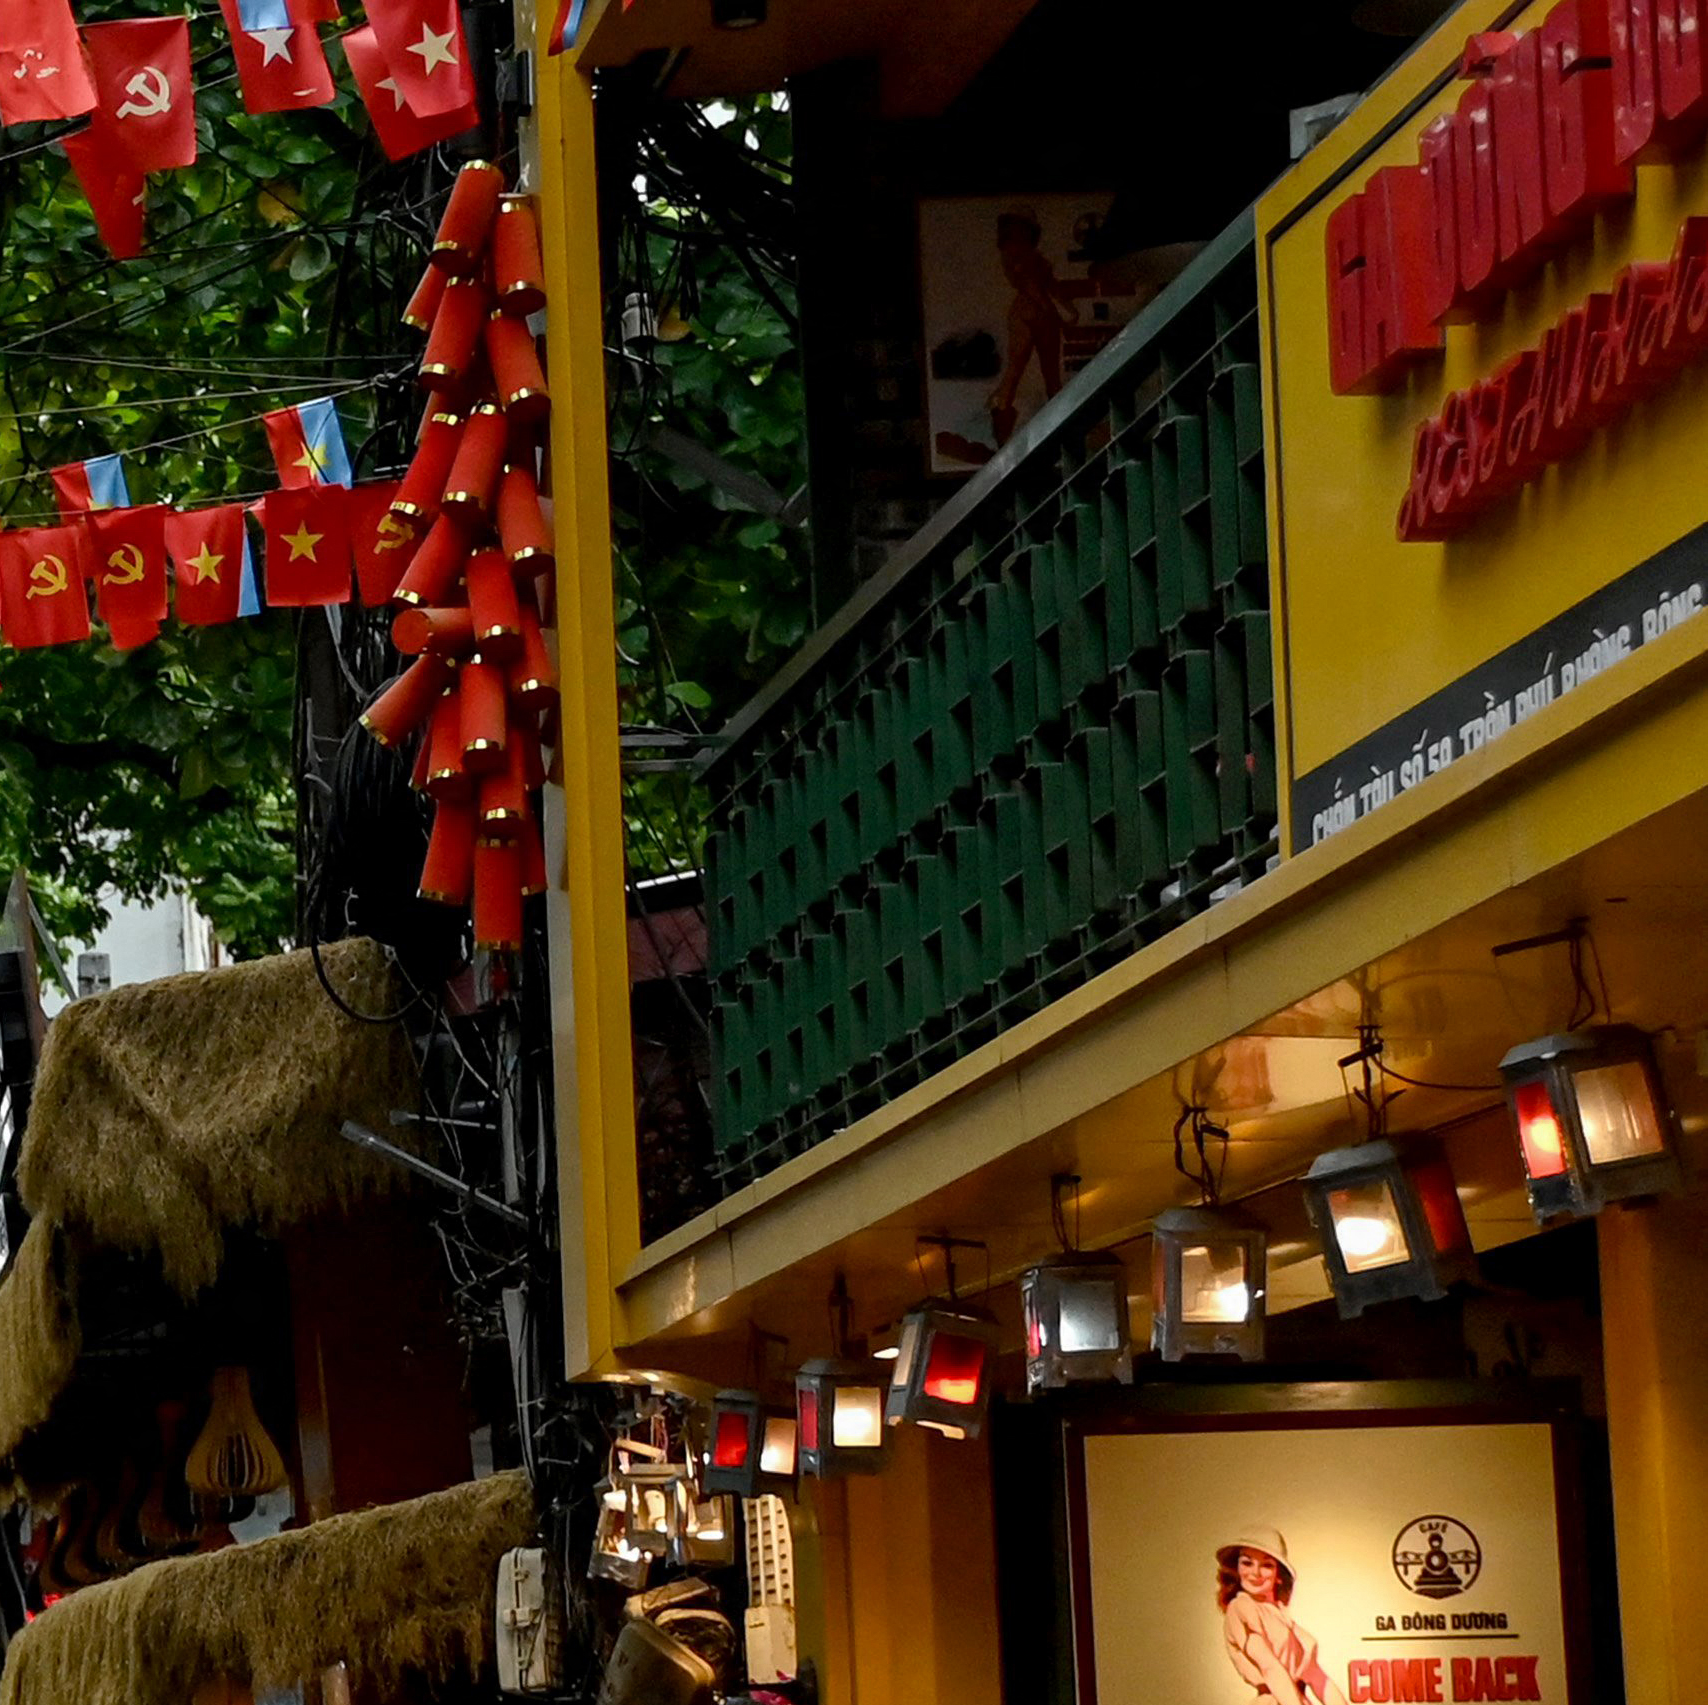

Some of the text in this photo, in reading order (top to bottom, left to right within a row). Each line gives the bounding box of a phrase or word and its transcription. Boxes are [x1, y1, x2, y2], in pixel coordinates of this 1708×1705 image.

[1376, 1615, 1396, 1631] GA
[1402, 1611, 1446, 1631] ĐÔNG
[1348, 1656, 1542, 1703] COME BACK
